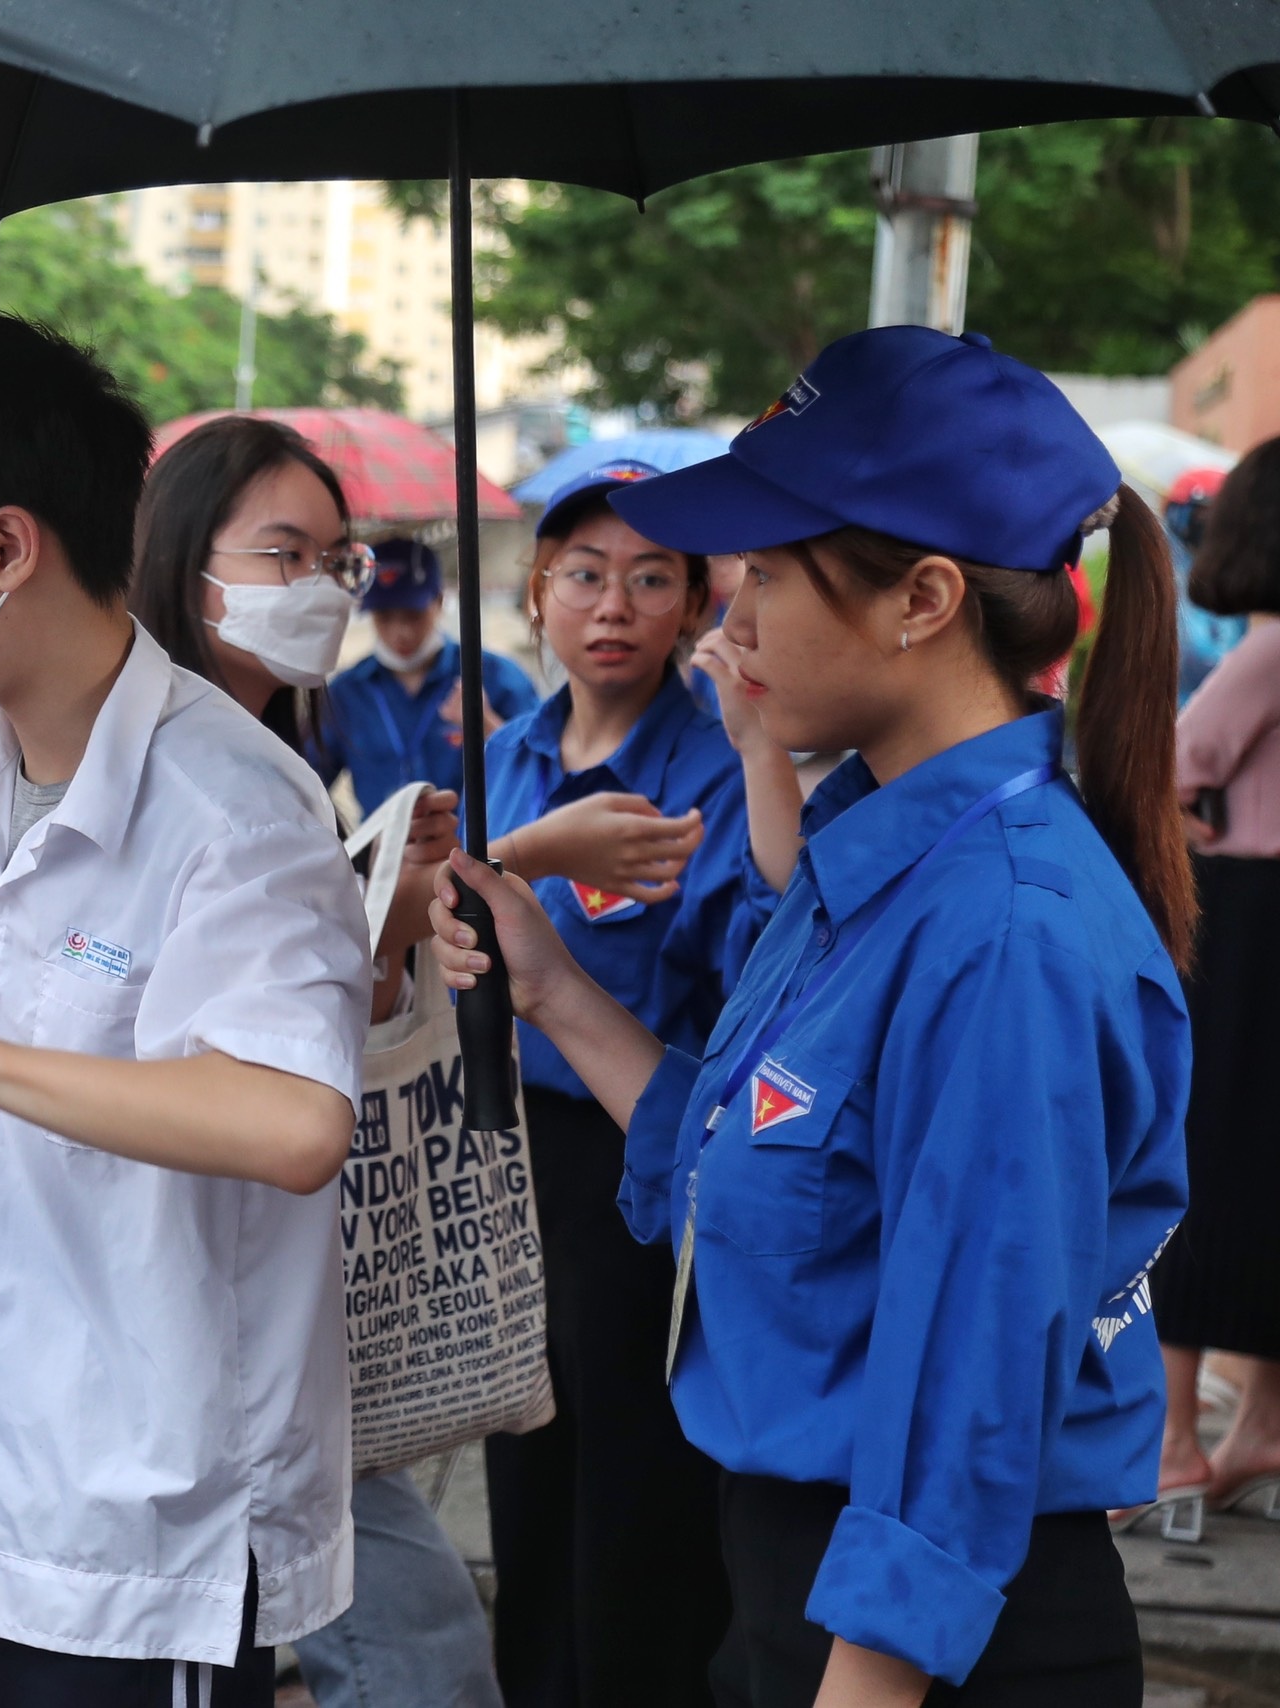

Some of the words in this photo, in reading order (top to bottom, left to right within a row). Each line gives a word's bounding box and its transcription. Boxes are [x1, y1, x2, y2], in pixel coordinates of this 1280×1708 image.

[340, 1146, 419, 1210] NDON
[343, 1233, 425, 1287] APORE
[433, 1198, 528, 1259] MOSCOW
[368, 1194, 420, 1246] YORK
[346, 1280, 400, 1319] GHAI
[407, 1254, 489, 1299] OSAKA
[358, 1304, 419, 1340] LUMPUR
[427, 1285, 494, 1319] SEOUL
[348, 1335, 403, 1363] ANCISCO
[408, 1322, 452, 1348] HONG
[456, 1308, 498, 1336] KONG
[359, 1360, 402, 1381] BERLIN
[406, 1332, 494, 1368] MELBOURNE
[391, 1362, 453, 1390] BARCELONA
